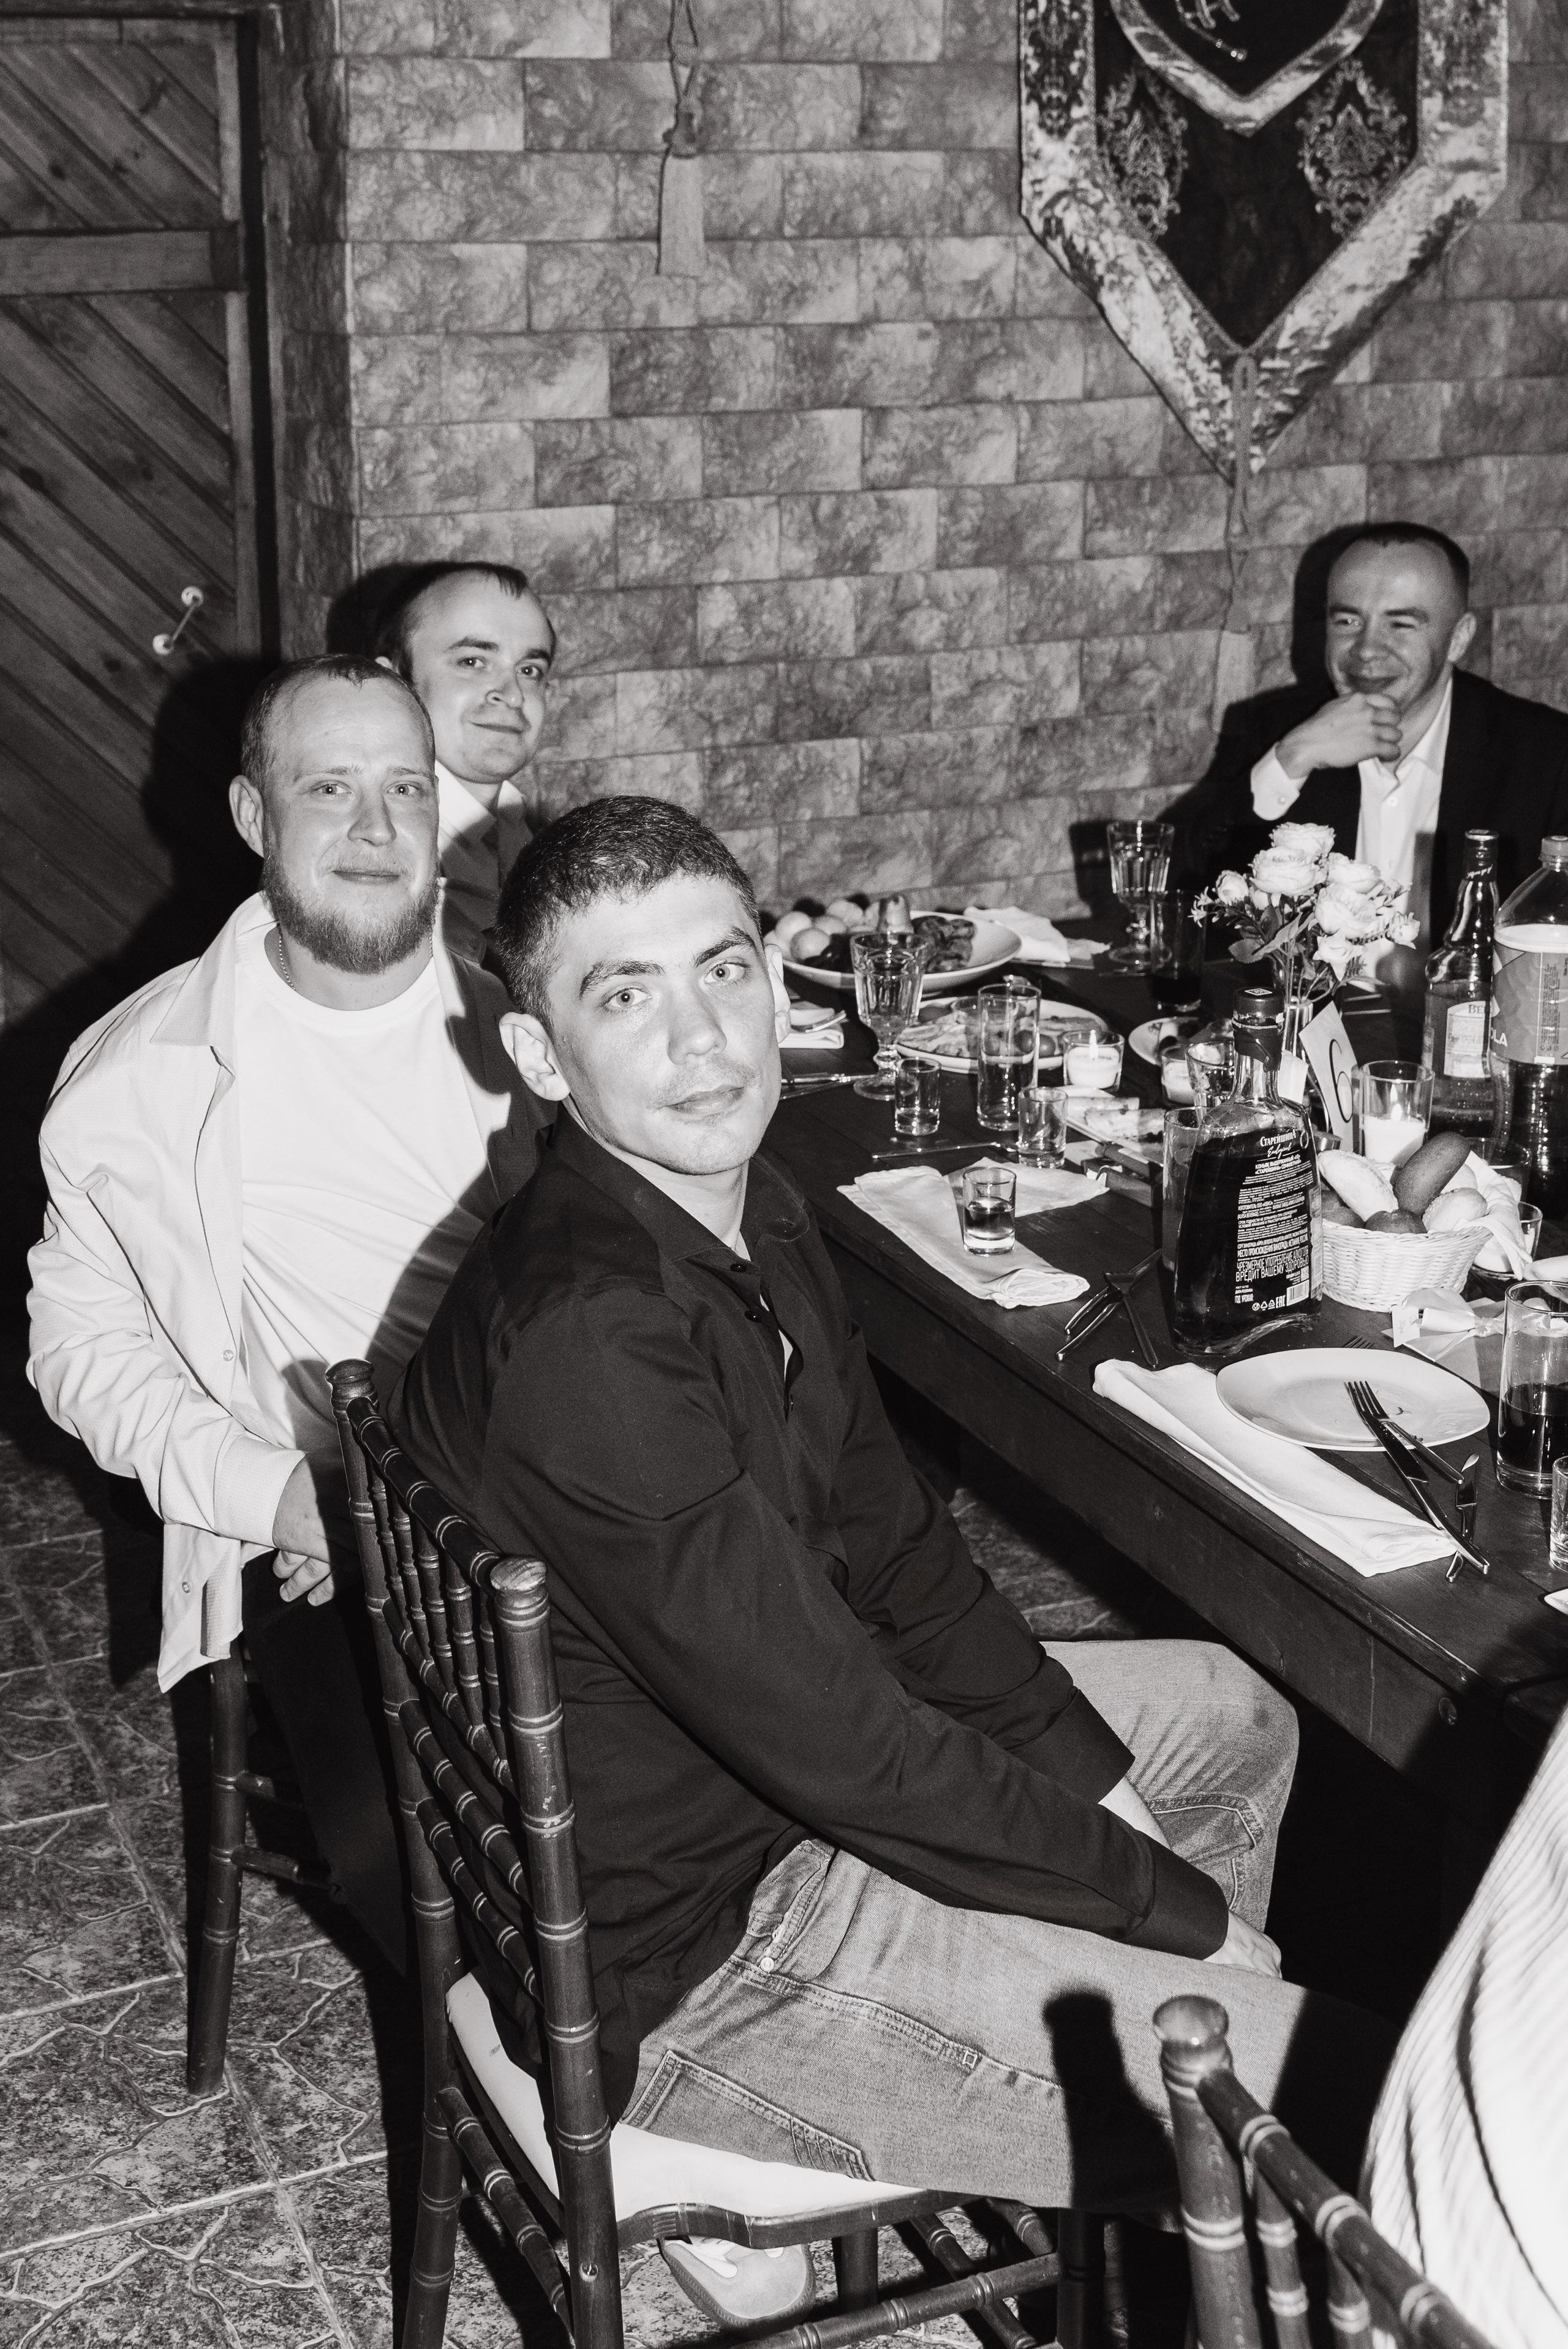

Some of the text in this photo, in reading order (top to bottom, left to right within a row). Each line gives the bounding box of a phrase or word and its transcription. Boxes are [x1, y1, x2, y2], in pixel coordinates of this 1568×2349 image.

[1236, 1268, 1260, 1282] ВРЕДИТ
[1261, 1263, 1284, 1278] ВАШЕМУ
[1285, 1255, 1309, 1273] ЗДОРОВЬЮ
[1237, 1258, 1265, 1271] ЧРЕЗМЕРНОЕ
[1265, 1251, 1292, 1268] УПОТРЕБЛЕНИЕ
